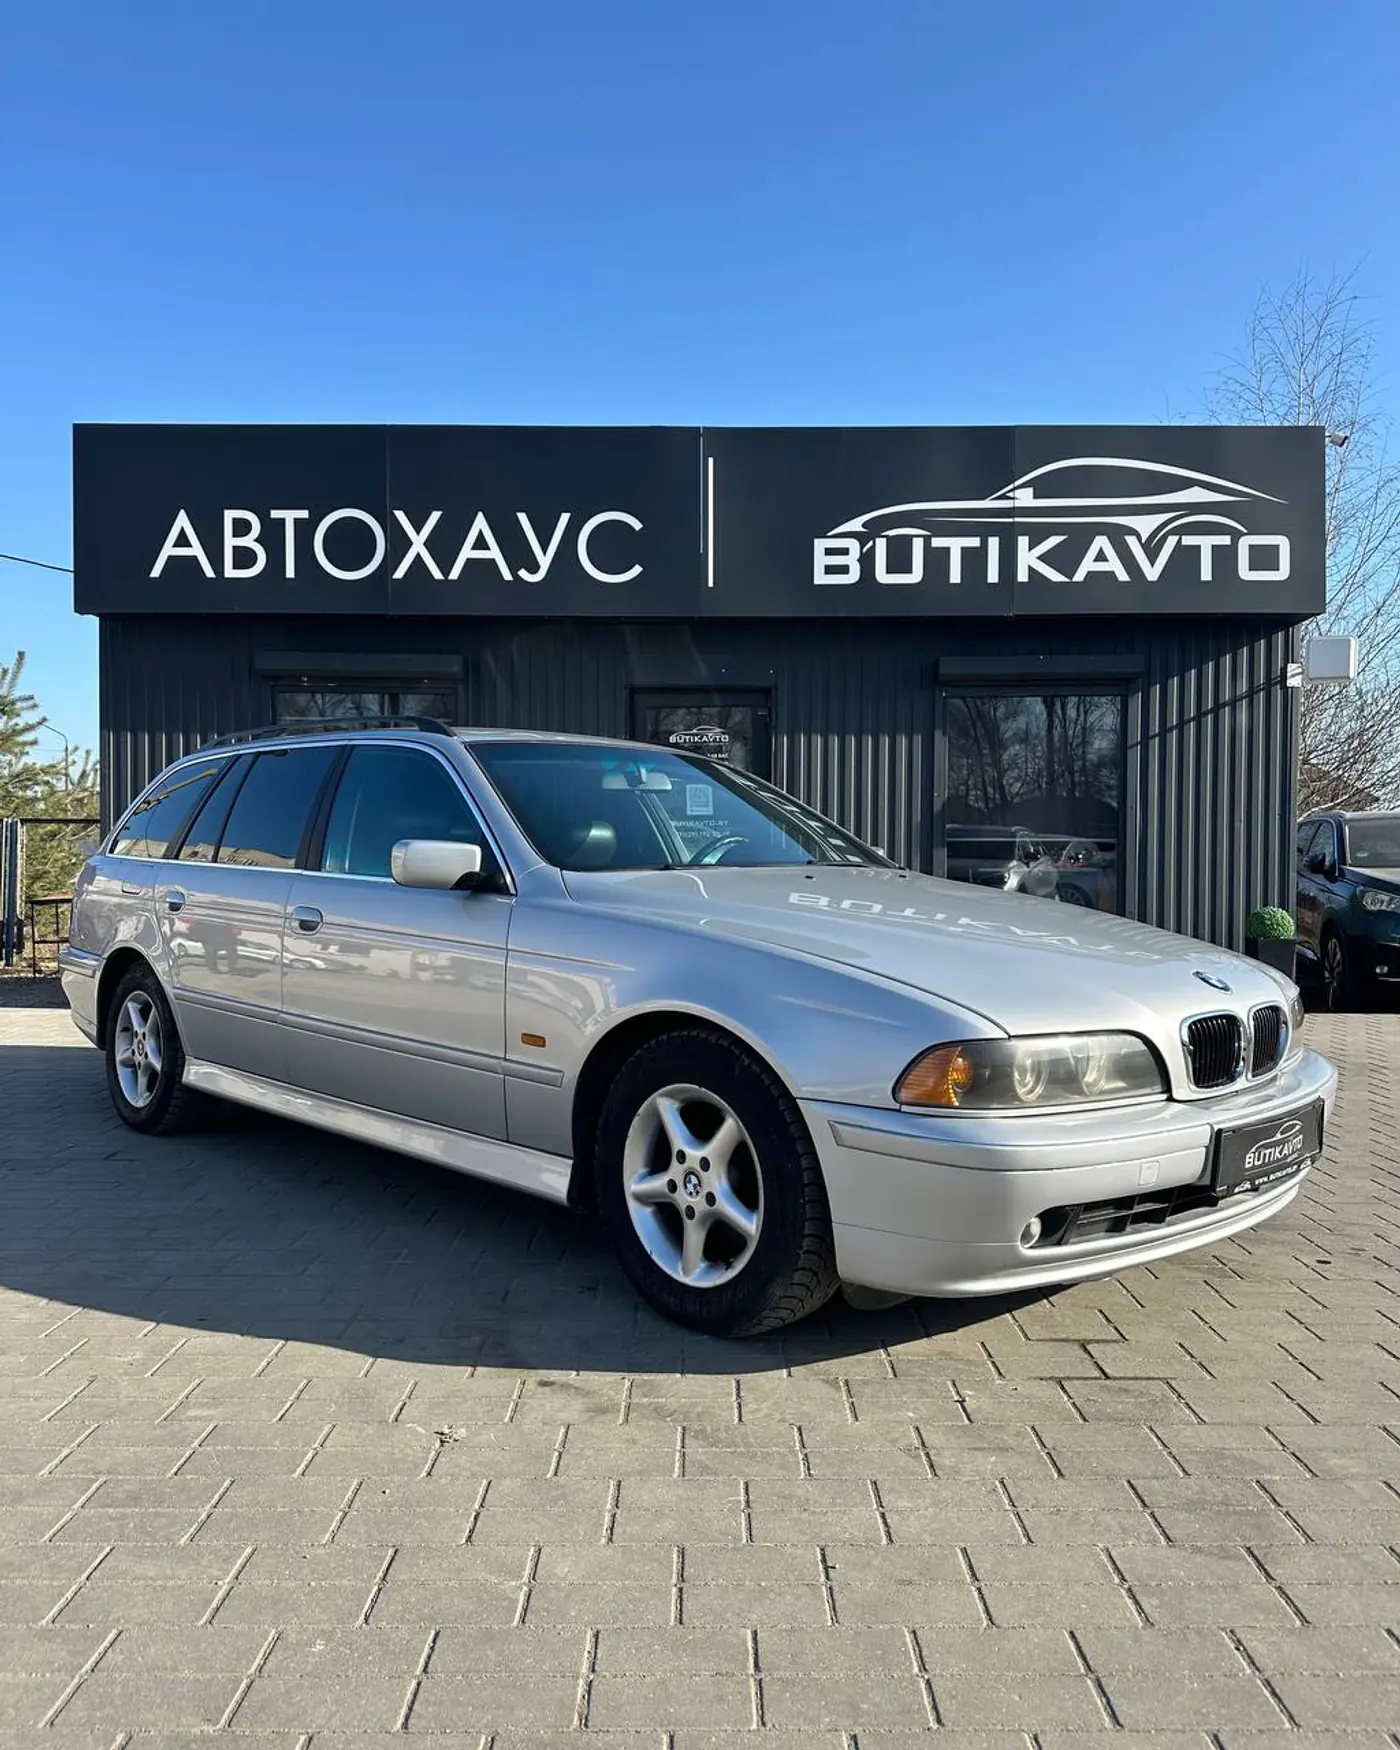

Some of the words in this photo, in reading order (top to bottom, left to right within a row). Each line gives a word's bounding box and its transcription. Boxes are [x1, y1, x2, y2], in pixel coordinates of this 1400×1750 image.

[149, 507, 644, 584] АВТОХАУС
[813, 534, 1291, 584] BUTIKAVTO
[669, 734, 729, 743] BUTIKAVTO
[1245, 1134, 1303, 1168] BUTIKAVTO
